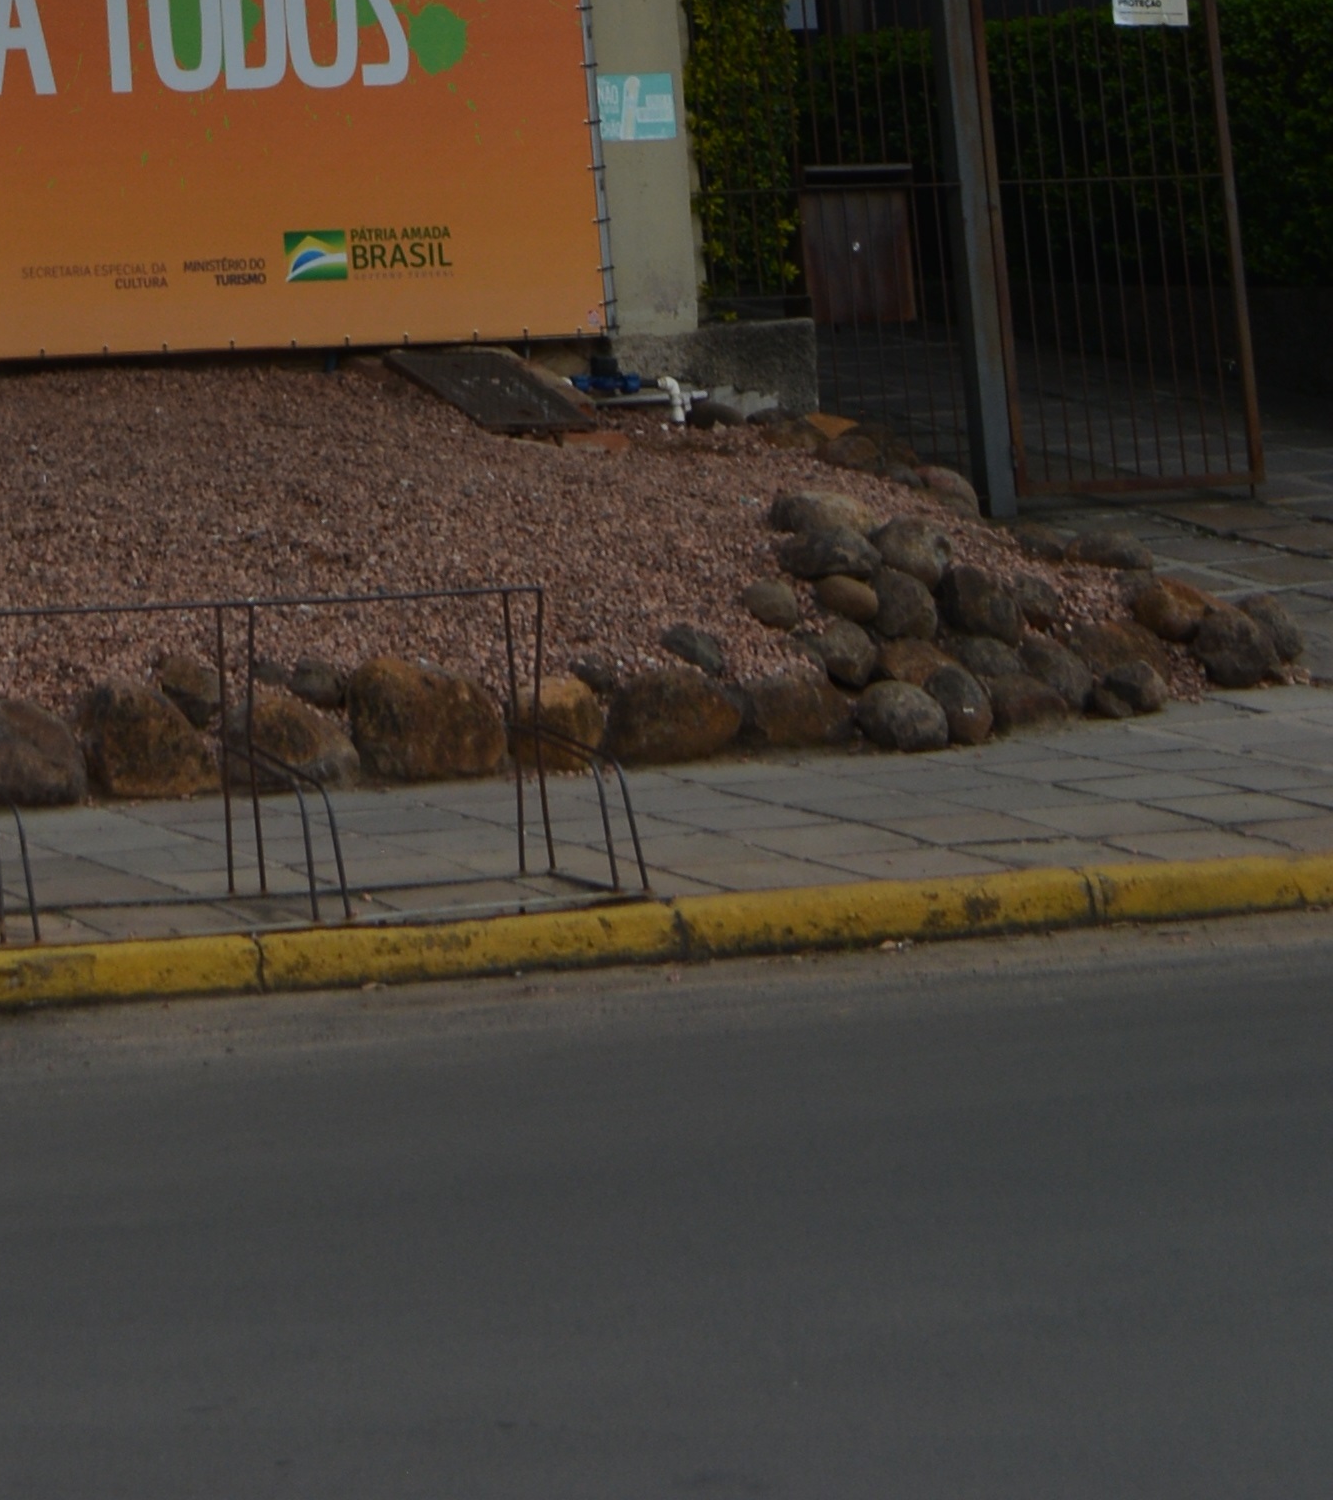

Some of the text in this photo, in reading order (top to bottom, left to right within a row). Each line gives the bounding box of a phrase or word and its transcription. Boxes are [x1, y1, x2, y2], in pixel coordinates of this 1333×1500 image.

[350, 225, 451, 242] PÁTRIA AMADA
[182, 256, 266, 273] MINISTÉRIO DO
[351, 242, 453, 270] BRASIL
[20, 262, 167, 279] SECRETARIA ESPECIAL DA
[114, 277, 169, 290] CULTURA
[214, 273, 267, 286] TURISMO
